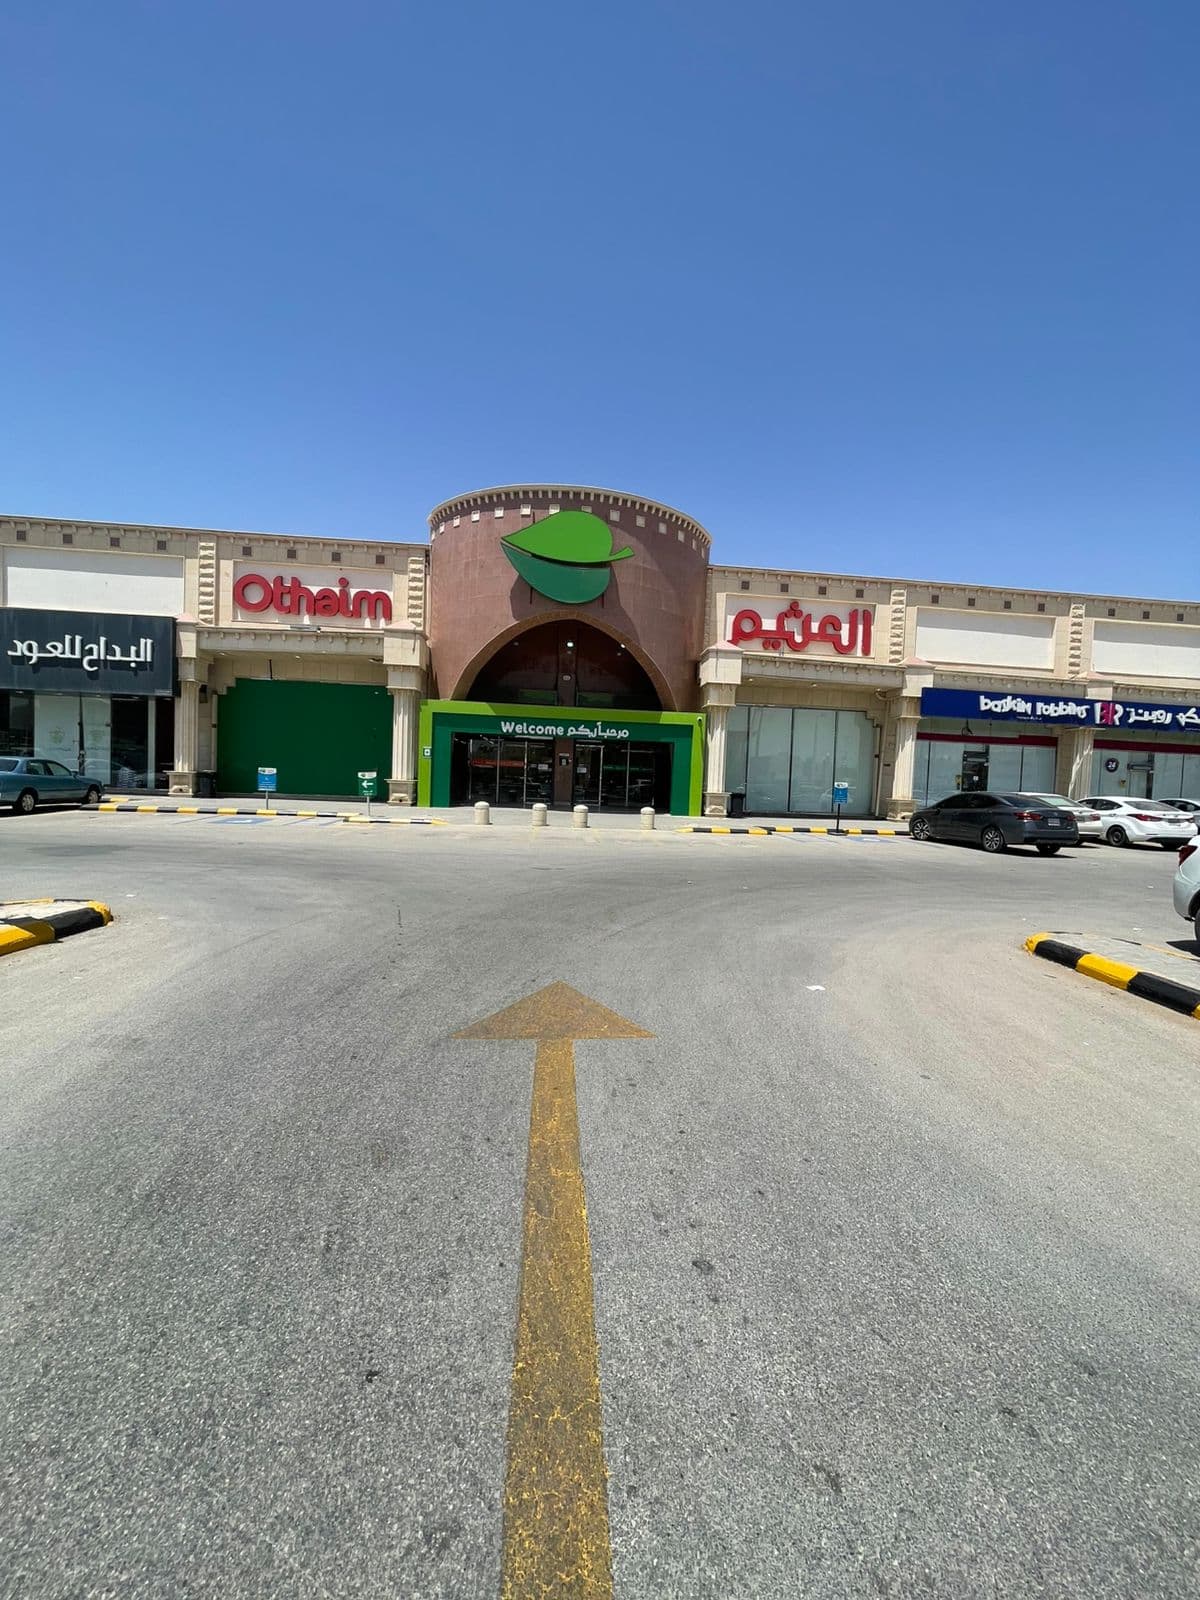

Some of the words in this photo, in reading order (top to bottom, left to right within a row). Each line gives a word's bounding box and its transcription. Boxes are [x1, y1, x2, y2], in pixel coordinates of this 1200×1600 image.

[233, 574, 392, 621] Othaim
[727, 601, 872, 656] العثيم
[7, 634, 82, 664] للعود
[83, 636, 153, 671] البداح
[979, 695, 1032, 715] baskin
[1036, 701, 1090, 719] robbins
[500, 721, 564, 736] Welcome
